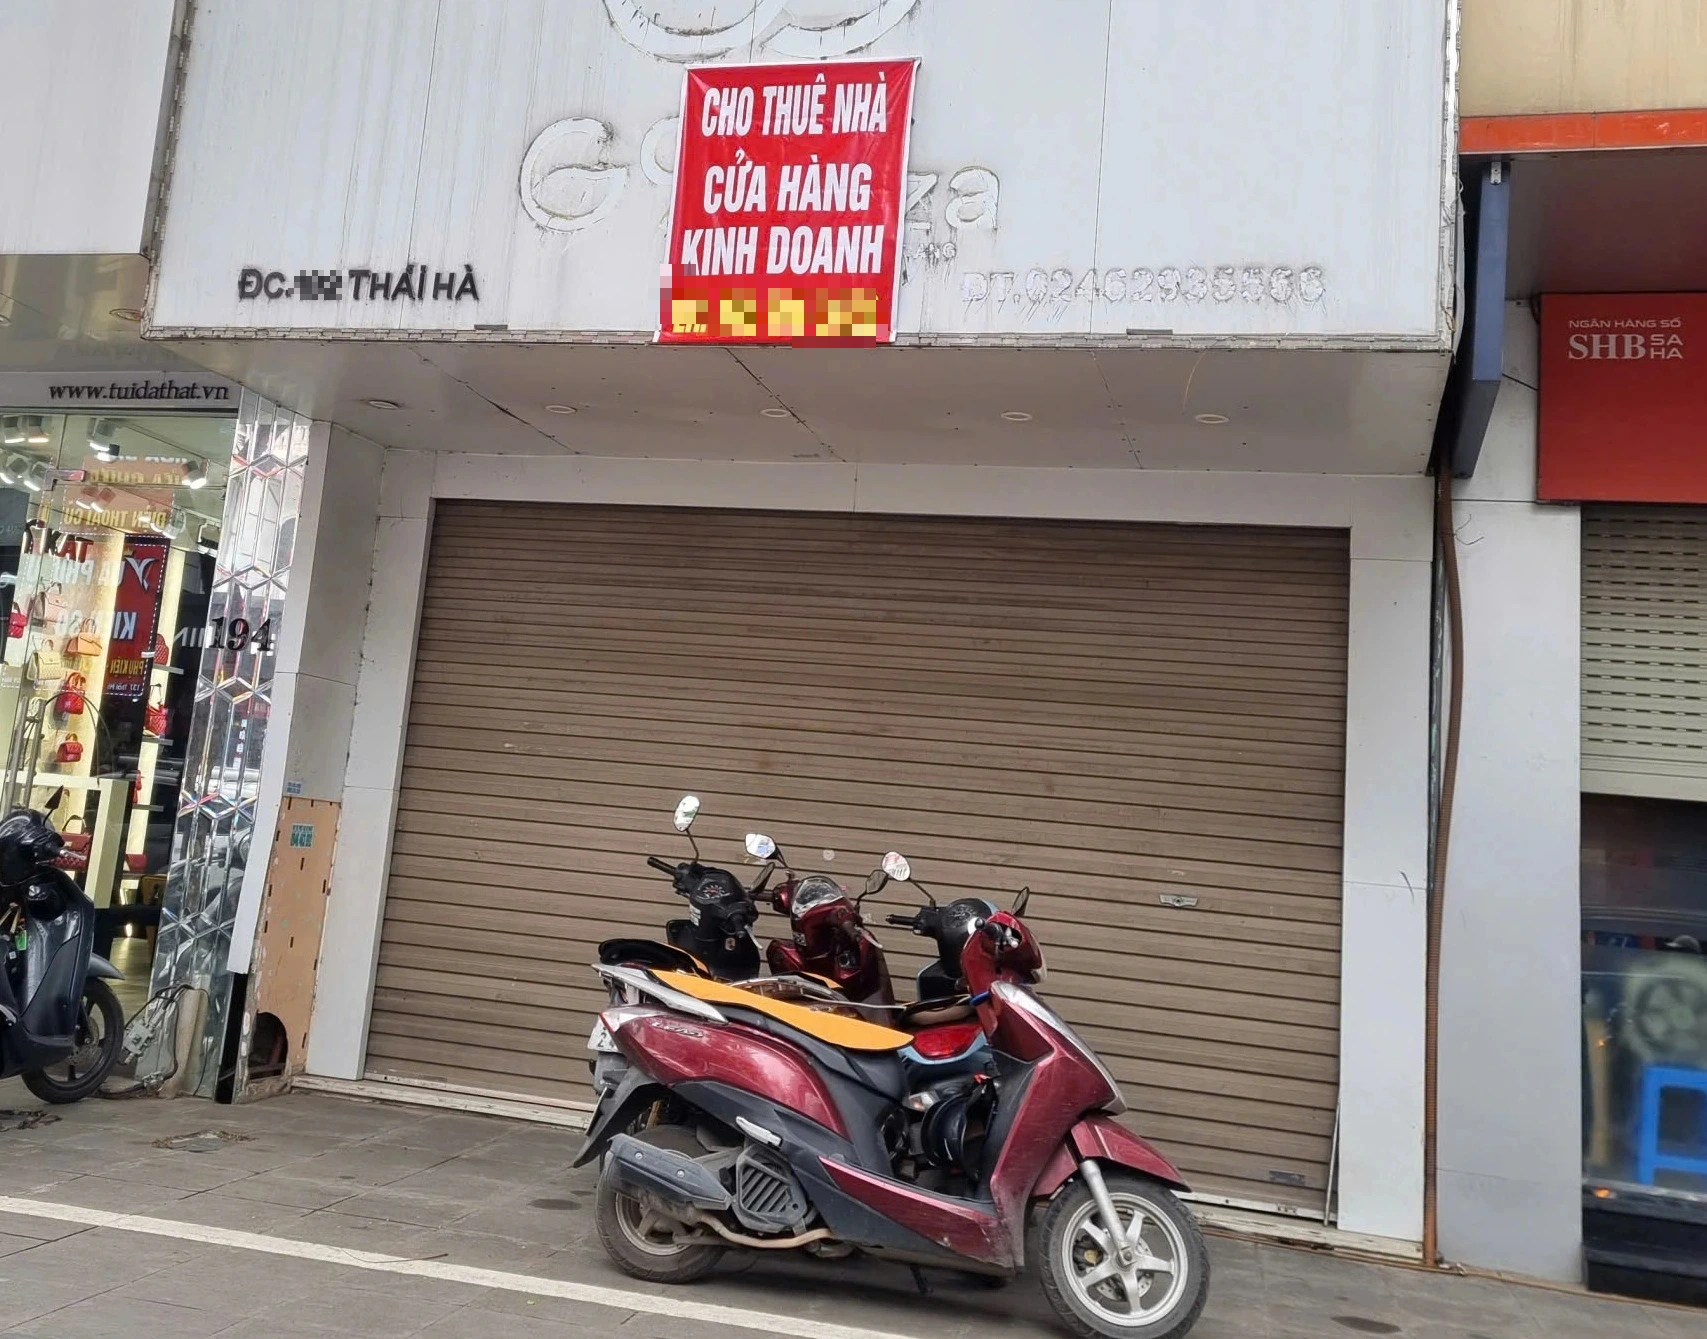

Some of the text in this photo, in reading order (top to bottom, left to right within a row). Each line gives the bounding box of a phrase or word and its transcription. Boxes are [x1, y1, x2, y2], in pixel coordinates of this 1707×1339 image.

[701, 72, 888, 137] CHO THUÊ NHÀ
[703, 149, 767, 214] CỬA
[776, 154, 872, 212] HÀNG
[681, 227, 760, 276] KINH
[766, 226, 885, 275] DOANH
[432, 264, 479, 300] HÀ
[1569, 316, 1682, 328] NGÂN HÀNG SỐ
[1568, 333, 1646, 360] SHB
[1650, 334, 1684, 346] SA
[1650, 347, 1684, 359] HA
[49, 380, 229, 400] www.tuidathat.vn
[209, 616, 275, 652] 194
